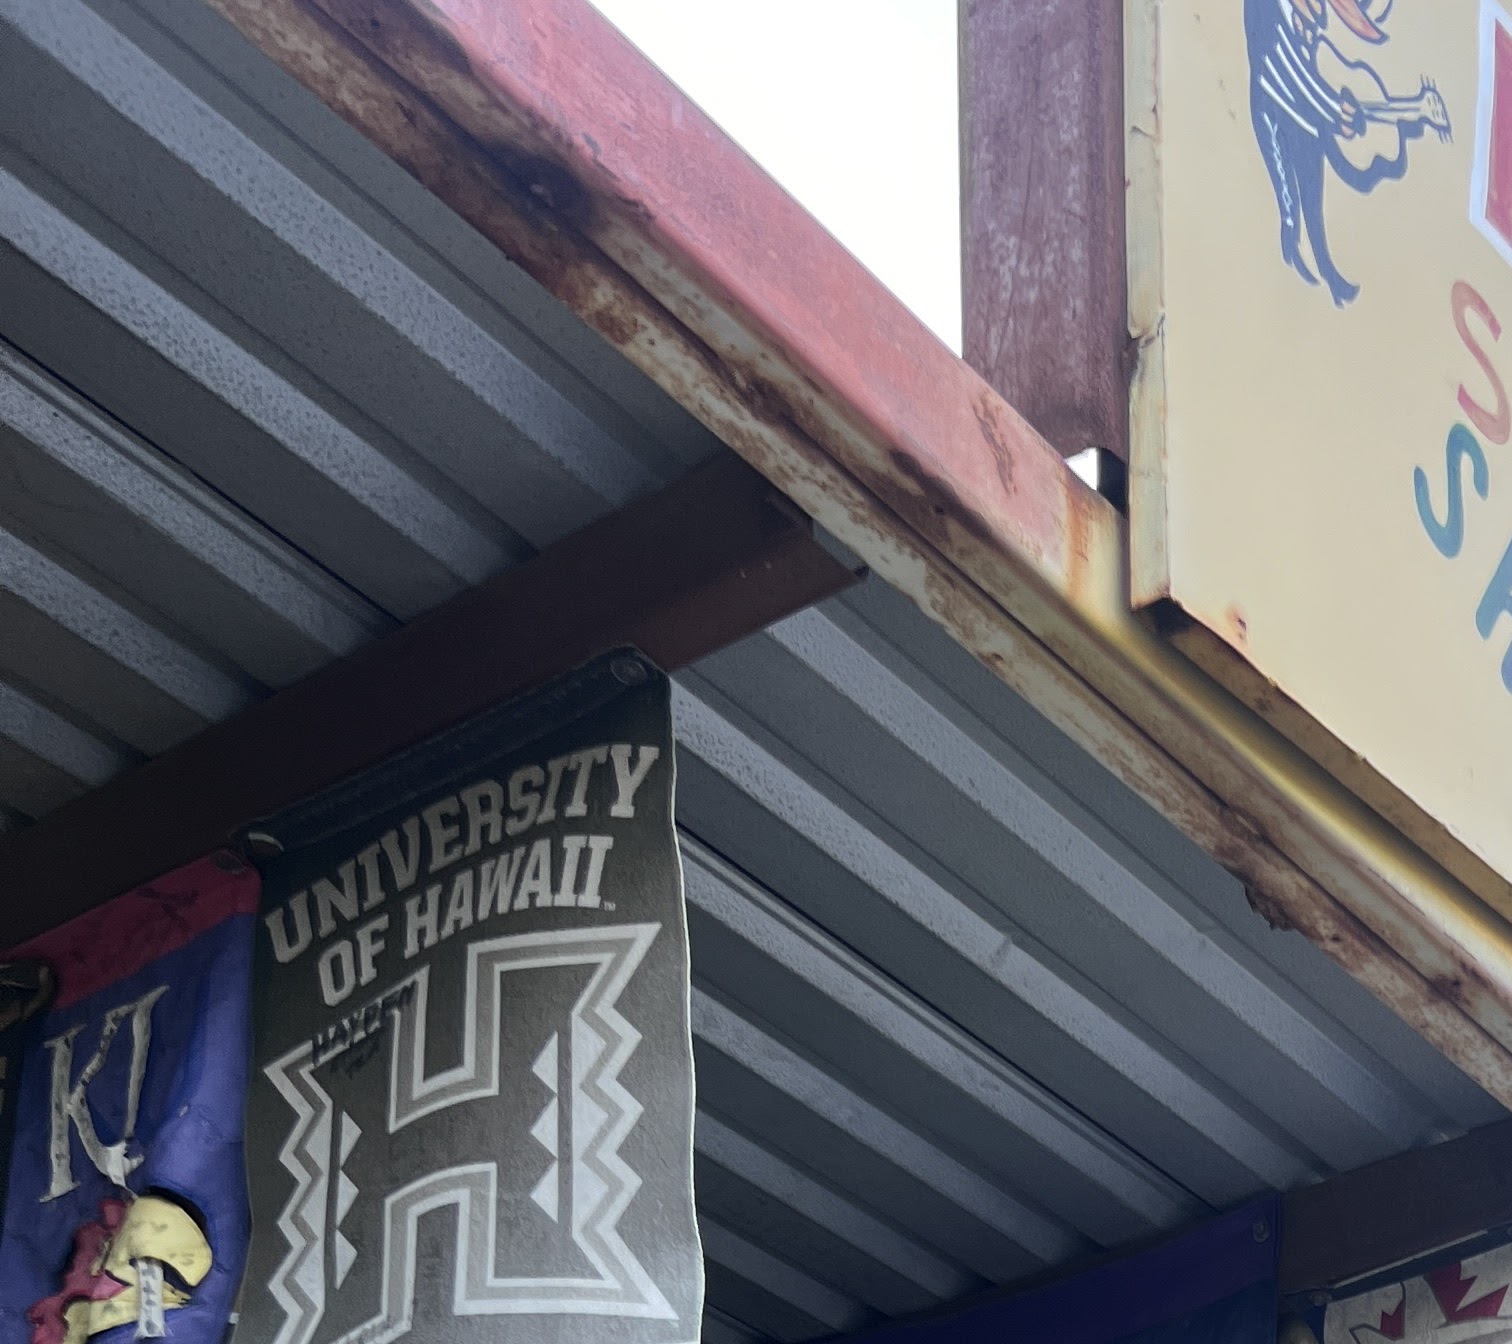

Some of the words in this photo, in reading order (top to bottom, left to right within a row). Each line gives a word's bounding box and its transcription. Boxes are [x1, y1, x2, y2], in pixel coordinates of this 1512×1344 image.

[265, 744, 661, 964] UNIVERSITY
[319, 932, 388, 1007] OF
[402, 834, 613, 962] HAWAII
